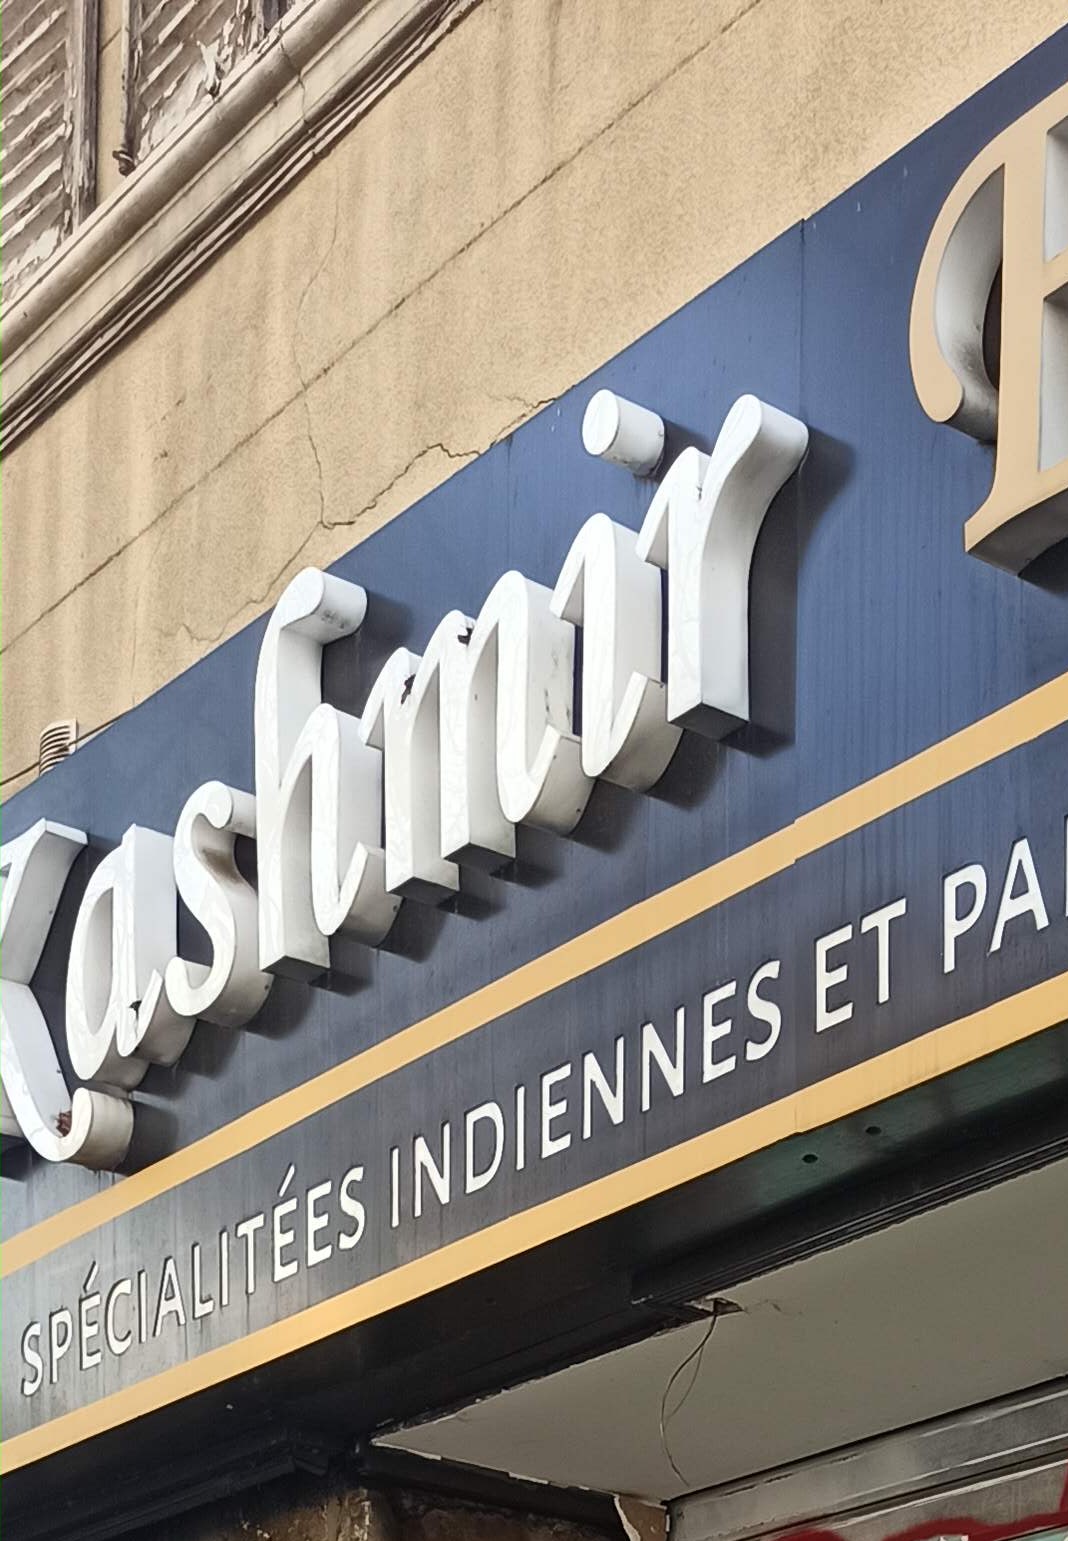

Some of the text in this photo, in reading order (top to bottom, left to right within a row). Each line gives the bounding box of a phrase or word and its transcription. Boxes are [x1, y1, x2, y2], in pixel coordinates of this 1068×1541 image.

[20, 1163, 367, 1398] SPÉCIALITÉES
[389, 959, 783, 1229] INDIENNES
[813, 896, 908, 1036] ET
